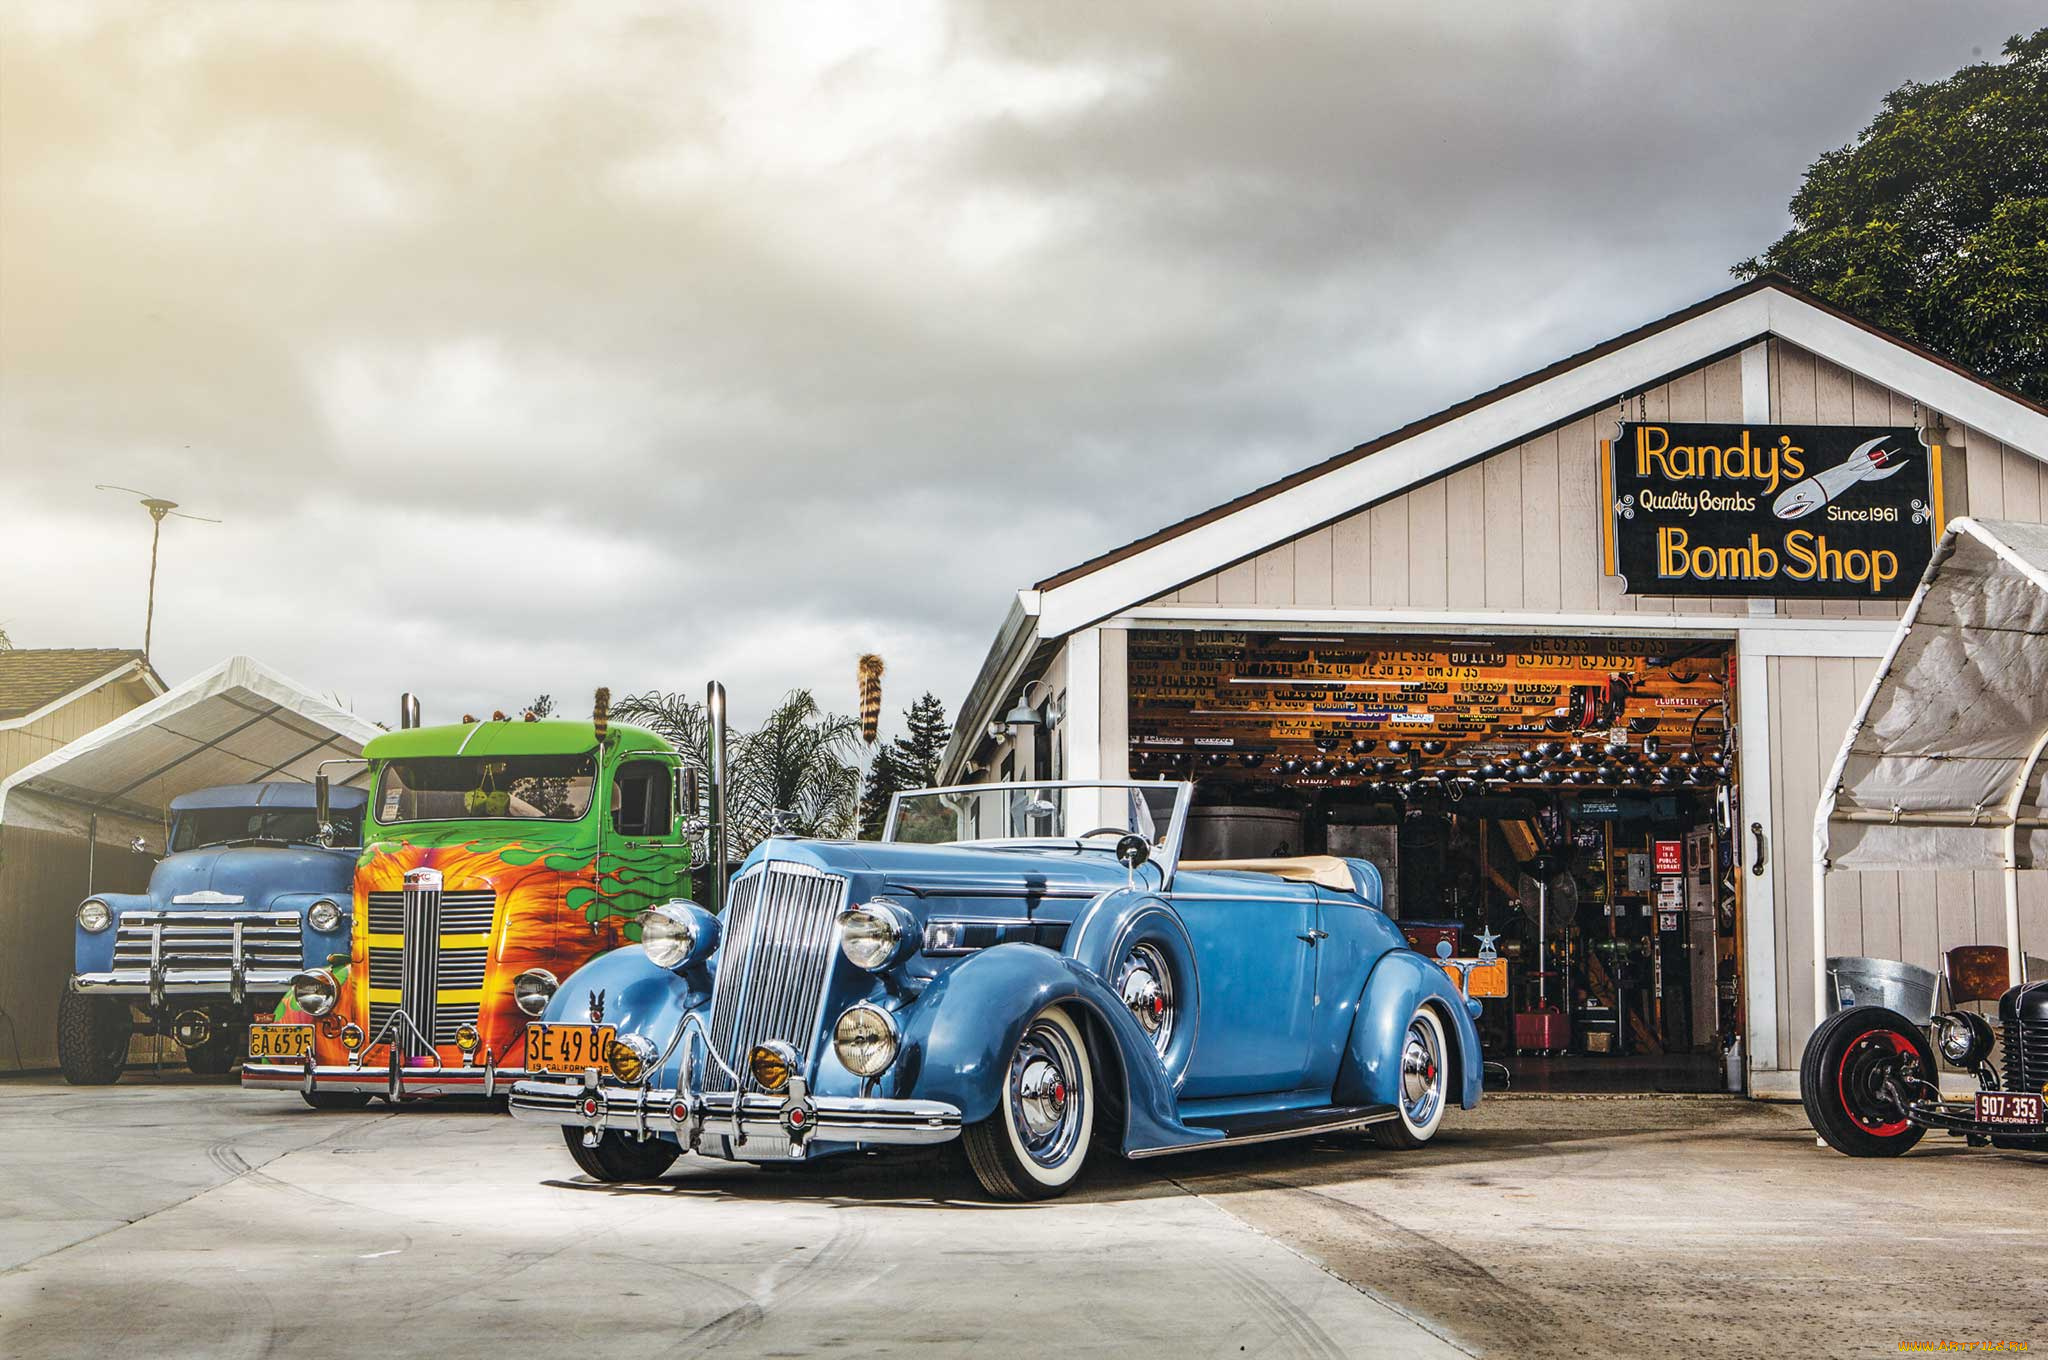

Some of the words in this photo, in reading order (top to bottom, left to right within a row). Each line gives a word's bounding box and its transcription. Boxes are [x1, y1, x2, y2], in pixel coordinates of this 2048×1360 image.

[1636, 426, 1805, 496] Randy's
[1640, 489, 1698, 517] Quality
[1700, 490, 1756, 512] Bombs
[1827, 506, 1869, 522] Since
[1870, 507, 1898, 522] 1961
[1658, 527, 1779, 578] Bomb
[1784, 529, 1899, 592] Shop
[530, 1030, 554, 1061] 3E
[561, 1031, 582, 1062] 49
[533, 1063, 542, 1071] 19
[1991, 1116, 2028, 1124] CALIFORNIA
